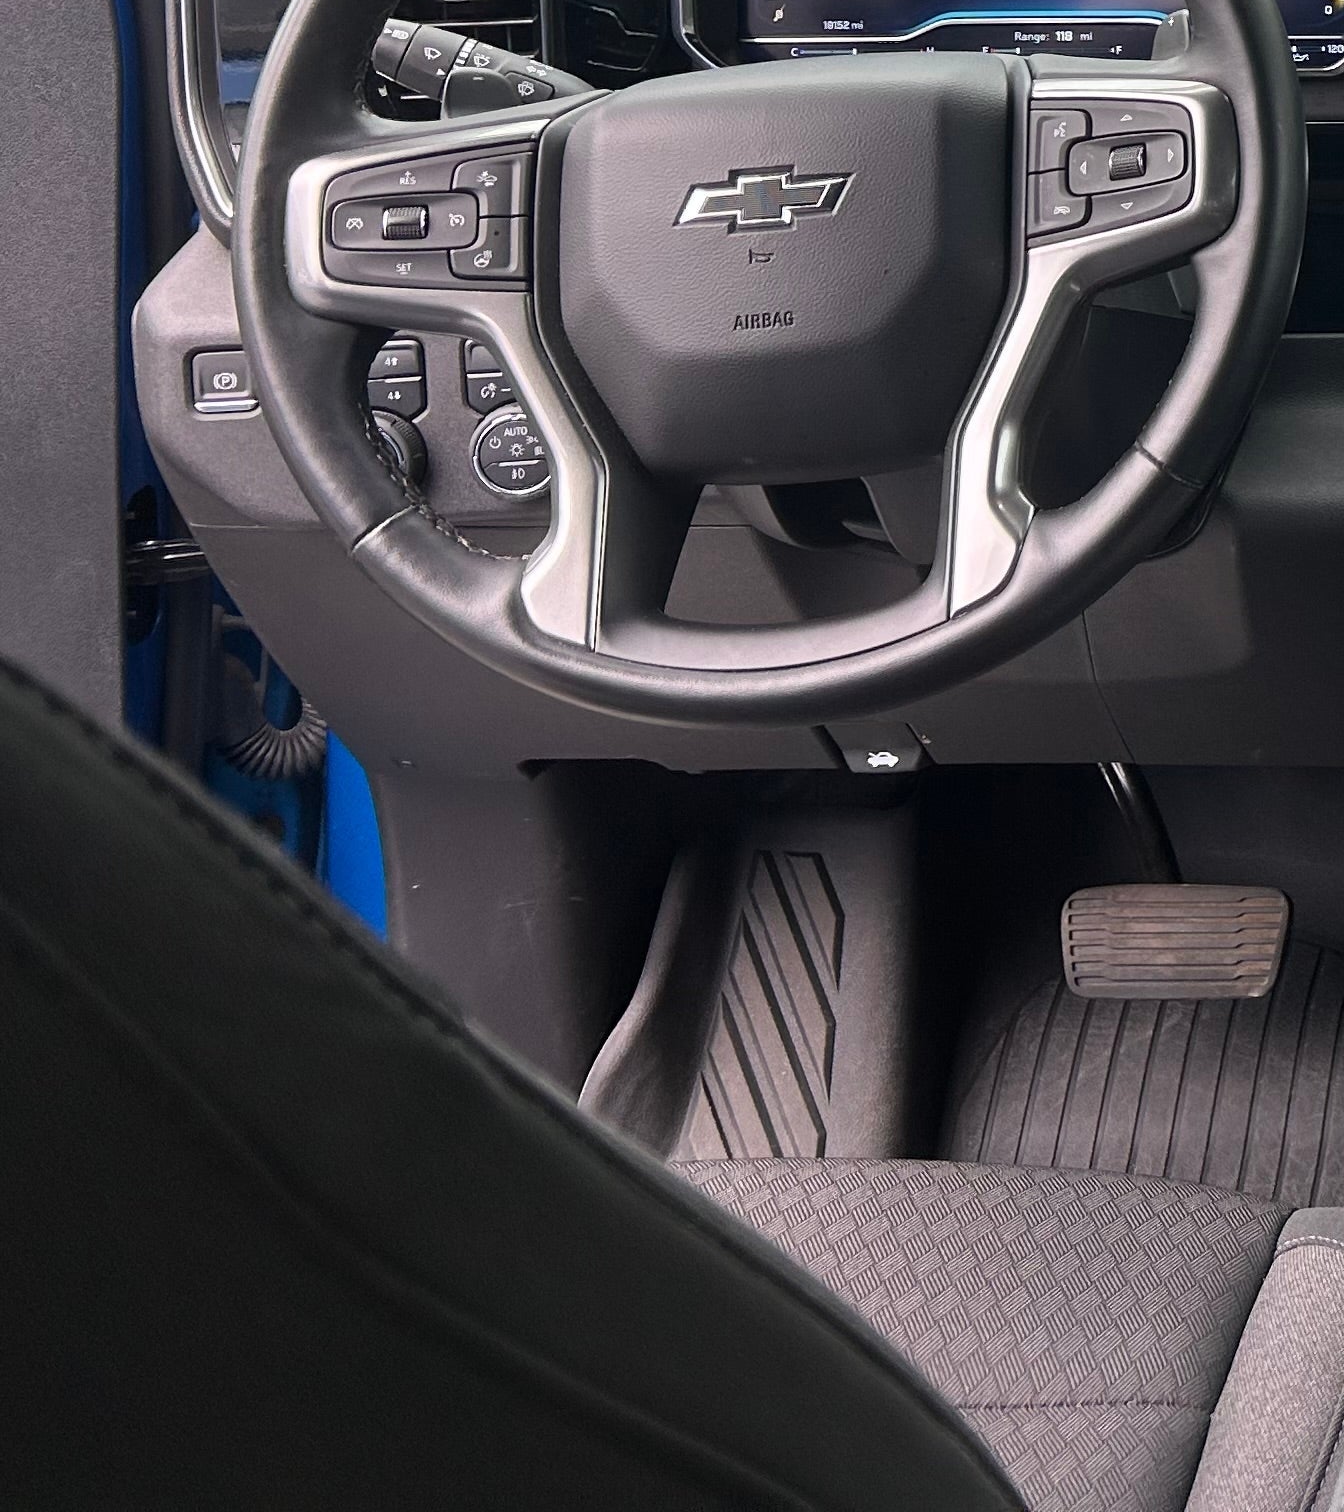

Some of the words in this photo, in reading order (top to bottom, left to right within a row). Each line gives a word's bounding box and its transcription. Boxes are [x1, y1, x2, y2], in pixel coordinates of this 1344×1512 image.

[1014, 31, 1050, 43] Range:
[1055, 31, 1073, 41] 118
[1080, 31, 1093, 41] mi
[790, 48, 799, 56] C
[1327, 44, 1344, 54] 120
[396, 263, 412, 272] SET
[731, 310, 795, 332] AIRBAG
[504, 426, 528, 437] AUTO
